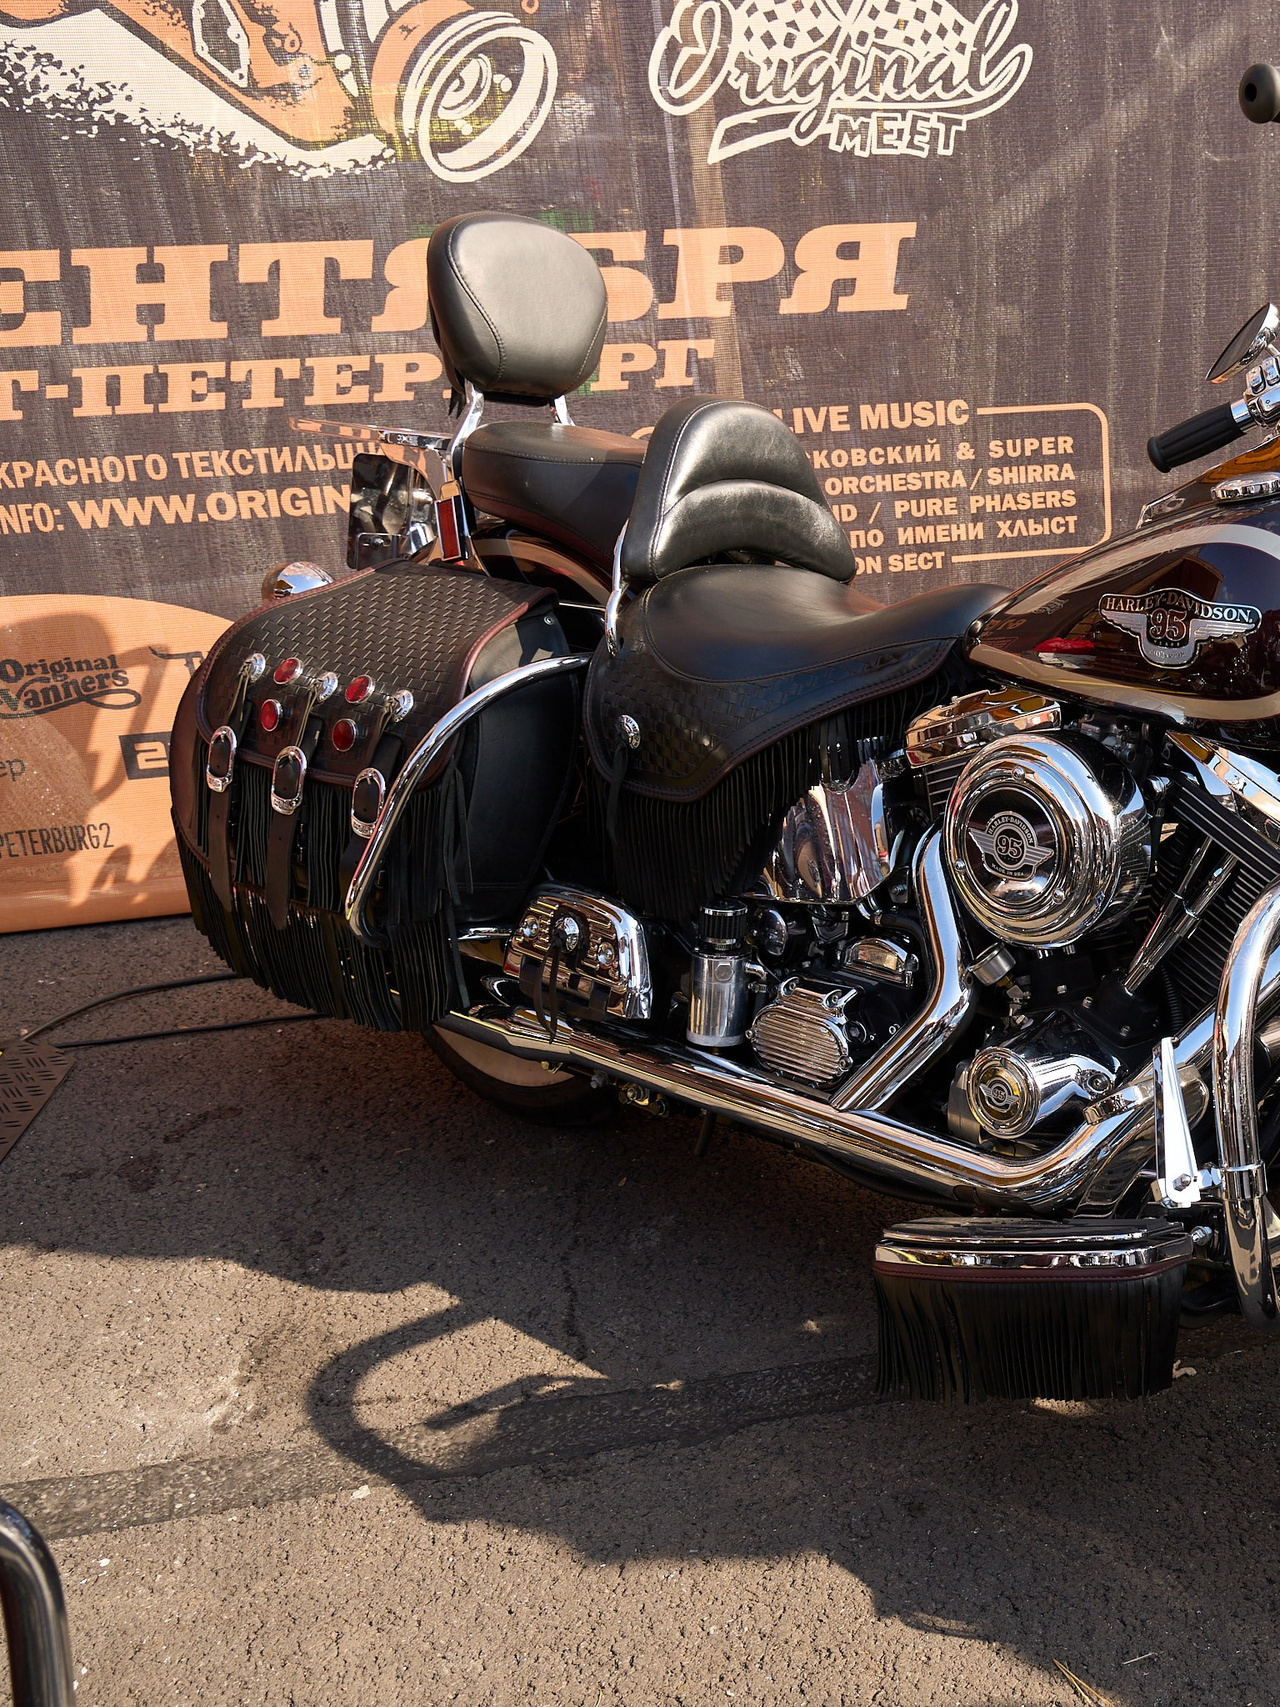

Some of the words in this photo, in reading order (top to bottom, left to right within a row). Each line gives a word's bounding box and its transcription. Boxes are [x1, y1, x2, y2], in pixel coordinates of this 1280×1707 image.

[648, 0, 1033, 150] Original
[828, 112, 968, 158] MEET
[859, 399, 970, 431] MUSIC
[806, 438, 941, 470] КОВСКИЙ
[957, 442, 975, 461] &
[989, 436, 1074, 458] SUPER
[824, 470, 966, 496] ORCHESTRA
[987, 463, 1076, 487] SHIRRA
[0, 502, 65, 535] NFO:
[894, 496, 958, 519] PURE
[970, 489, 1077, 514] PHASERS
[898, 521, 985, 546] ИМЕНИ
[996, 515, 1078, 539] ХЛЫСТ
[888, 551, 945, 573] SECT
[1149, 608, 1187, 641] 95
[0, 654, 119, 684] Original
[988, 816, 1033, 844] HARLEY-DAVIDSON
[996, 835, 1023, 859] 95
[992, 1089, 1006, 1101] 95
